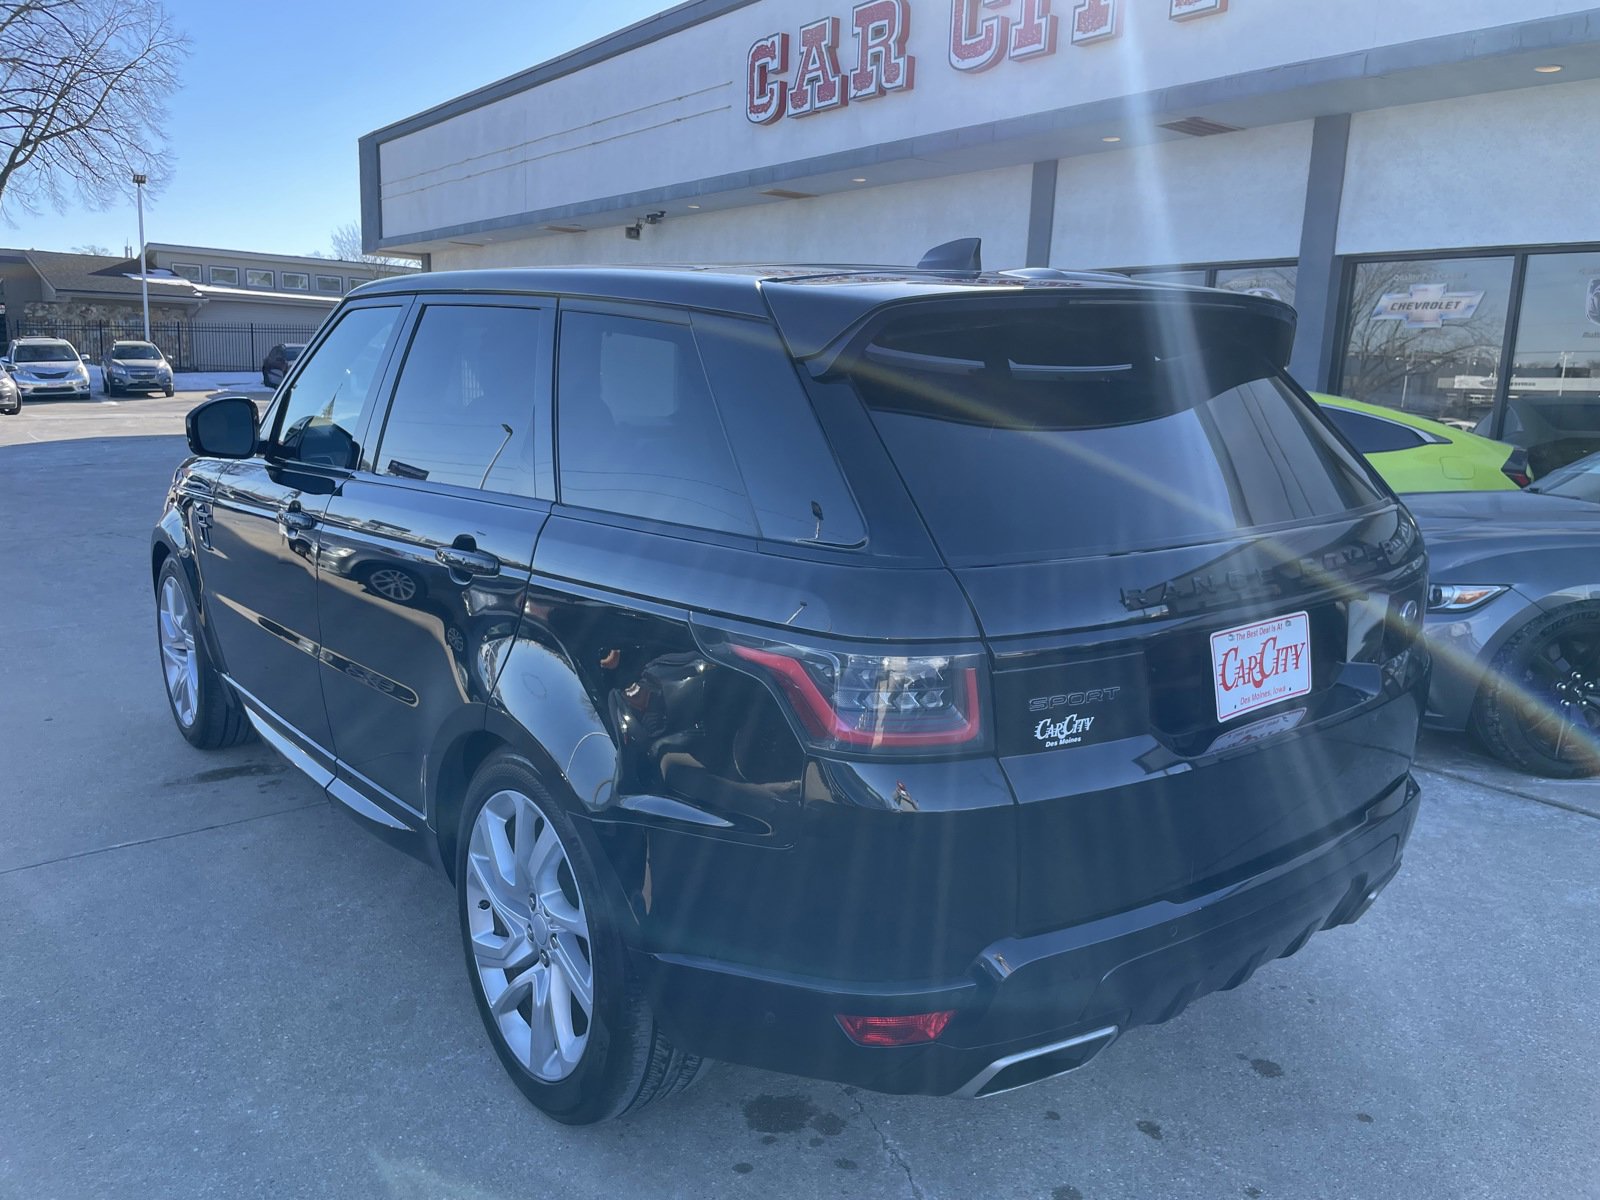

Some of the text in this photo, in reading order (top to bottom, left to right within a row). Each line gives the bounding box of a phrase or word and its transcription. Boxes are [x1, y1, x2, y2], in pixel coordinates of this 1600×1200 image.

[746, 0, 916, 126] CAR
[1390, 301, 1462, 311] CHEVROLET
[1236, 632, 1246, 641] The
[1246, 629, 1259, 639] Best
[1259, 626, 1271, 636] Deal
[1276, 623, 1283, 632] At
[1029, 686, 1121, 712] SPORT
[1240, 696, 1251, 706] Des
[1272, 685, 1286, 695] Iowa
[1045, 736, 1082, 748] Des Moines
